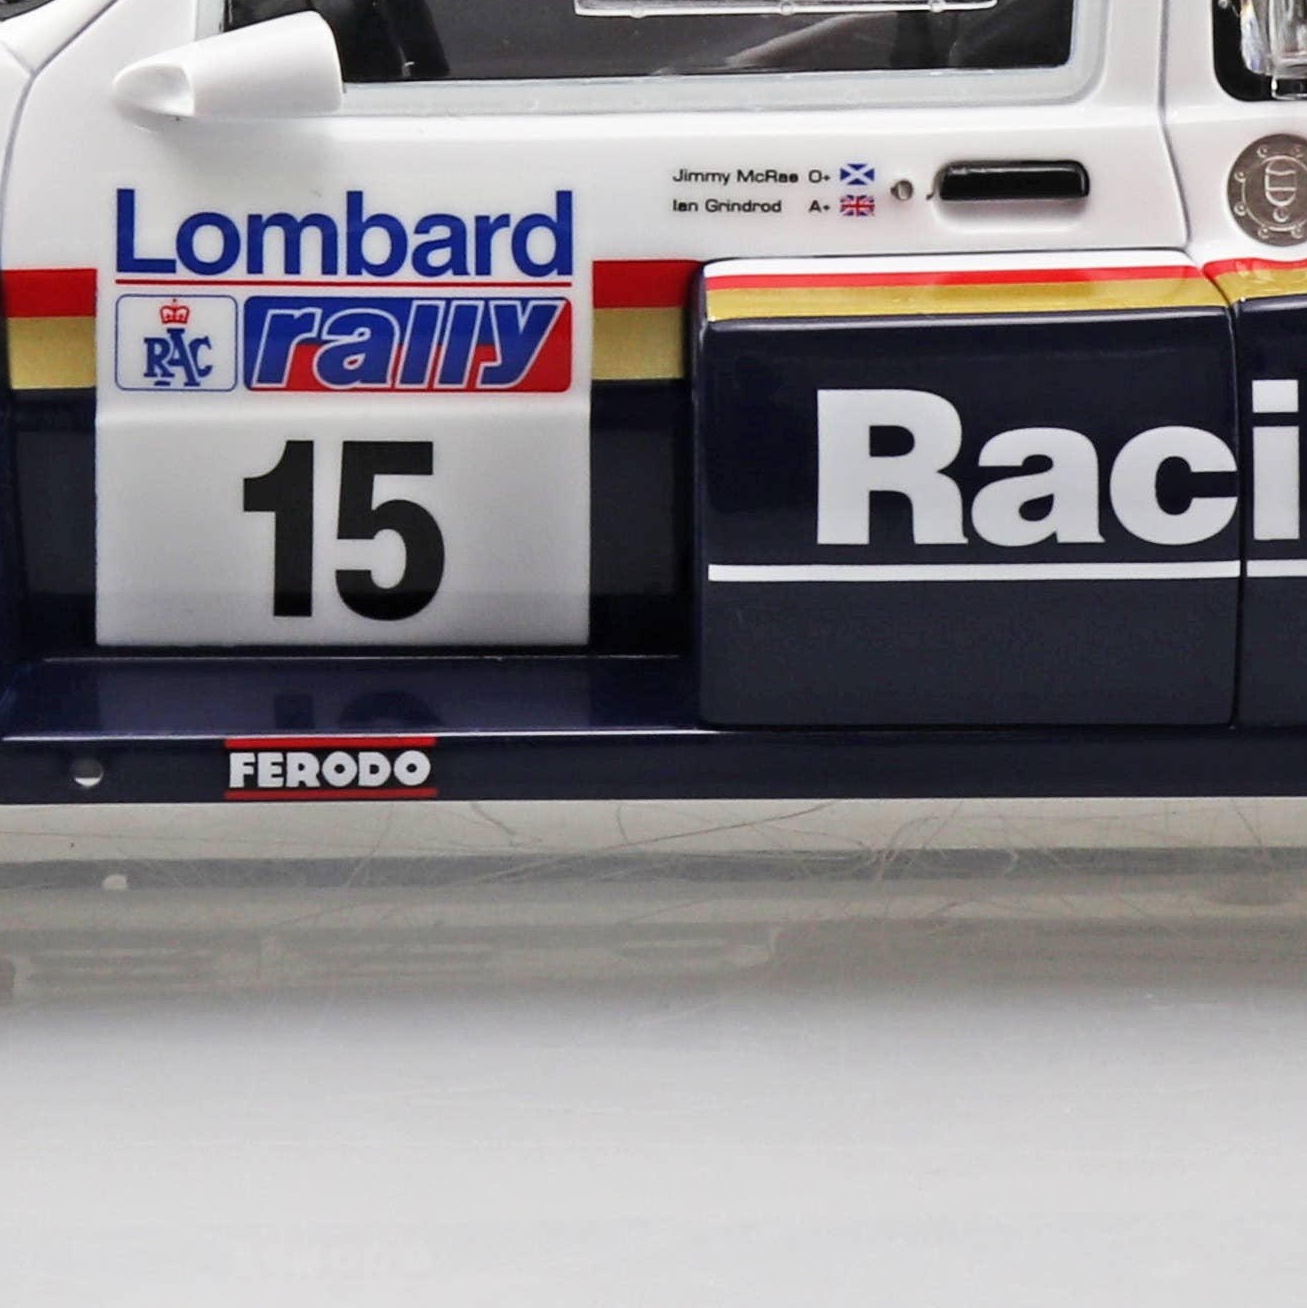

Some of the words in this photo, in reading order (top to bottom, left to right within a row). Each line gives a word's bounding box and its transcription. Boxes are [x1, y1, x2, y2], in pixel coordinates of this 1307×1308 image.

[672, 169, 731, 186] Jimmy
[736, 169, 799, 184] McRae
[672, 199, 699, 213] Ian
[704, 198, 782, 213] Grindrod
[115, 188, 574, 278] Lombard
[142, 327, 213, 387] RAC
[250, 298, 568, 391] rally
[243, 439, 446, 621] 15
[229, 750, 431, 788] FERODO
